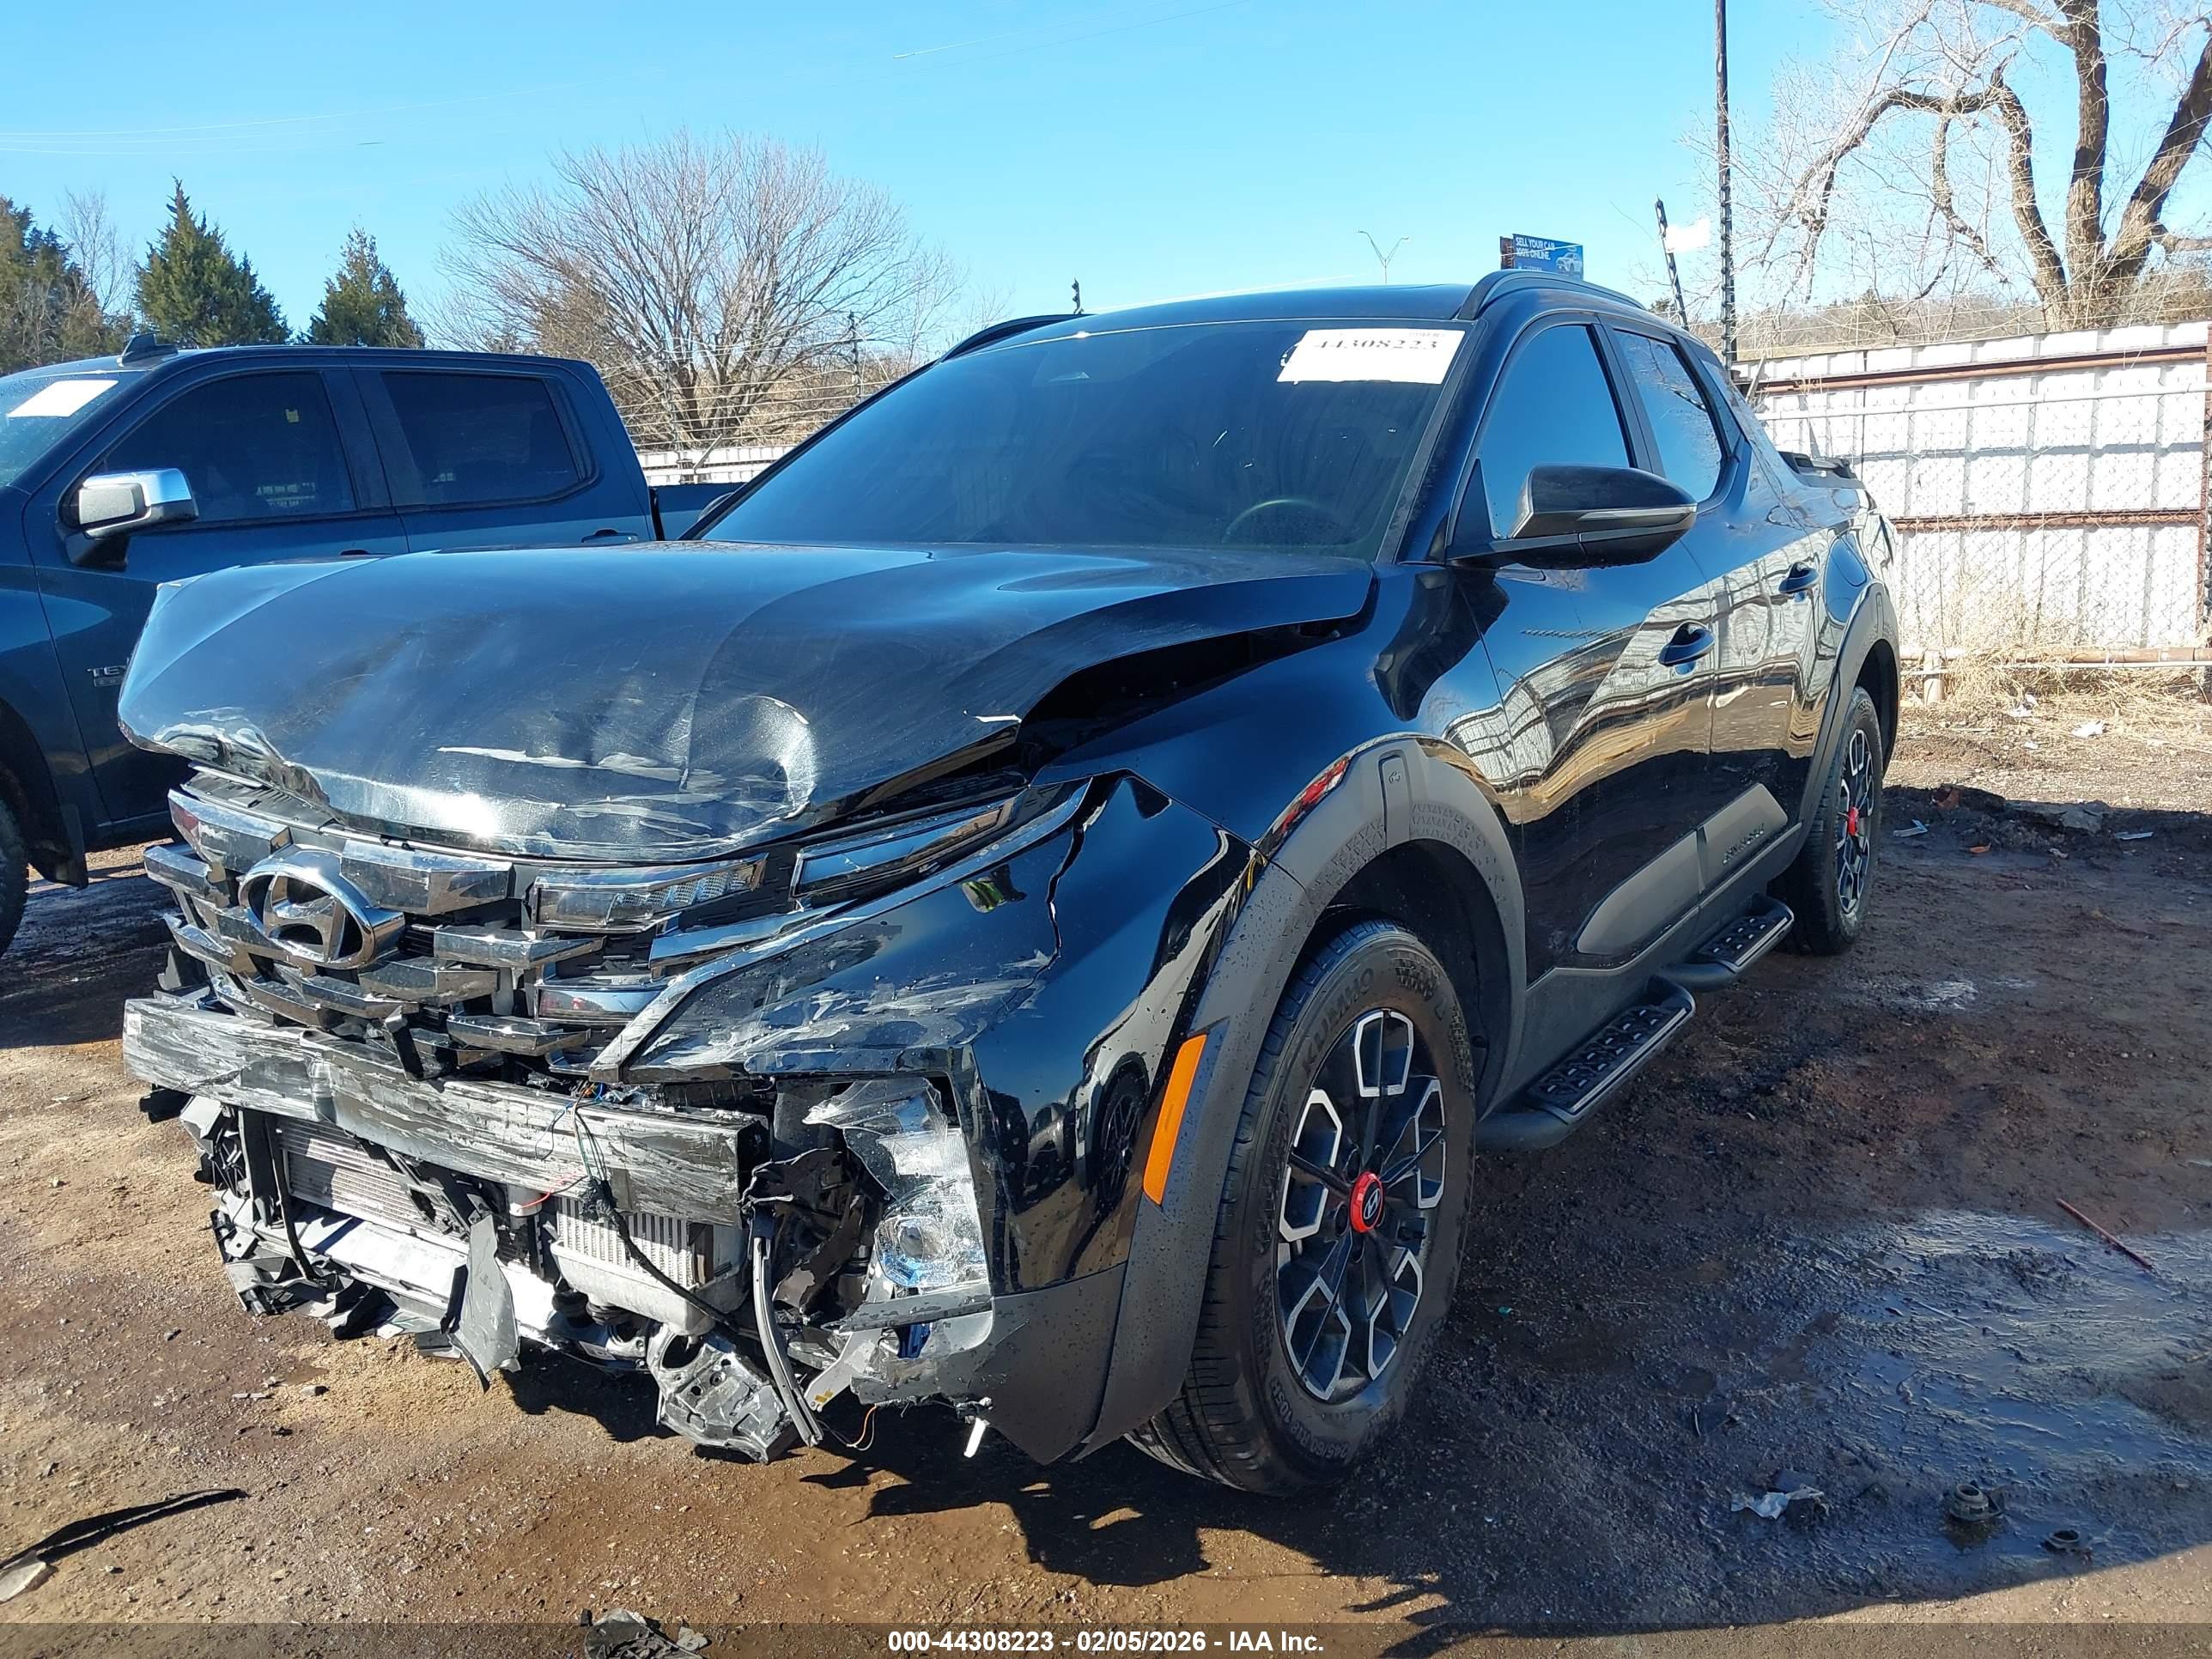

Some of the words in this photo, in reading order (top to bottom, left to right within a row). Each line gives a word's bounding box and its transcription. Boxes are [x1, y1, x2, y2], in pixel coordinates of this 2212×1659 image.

[1516, 237, 1528, 246] SELL
[1528, 239, 1544, 249] YOUR
[1315, 339, 1438, 349] 44308223
[1301, 968, 1375, 1078] KUMHO
